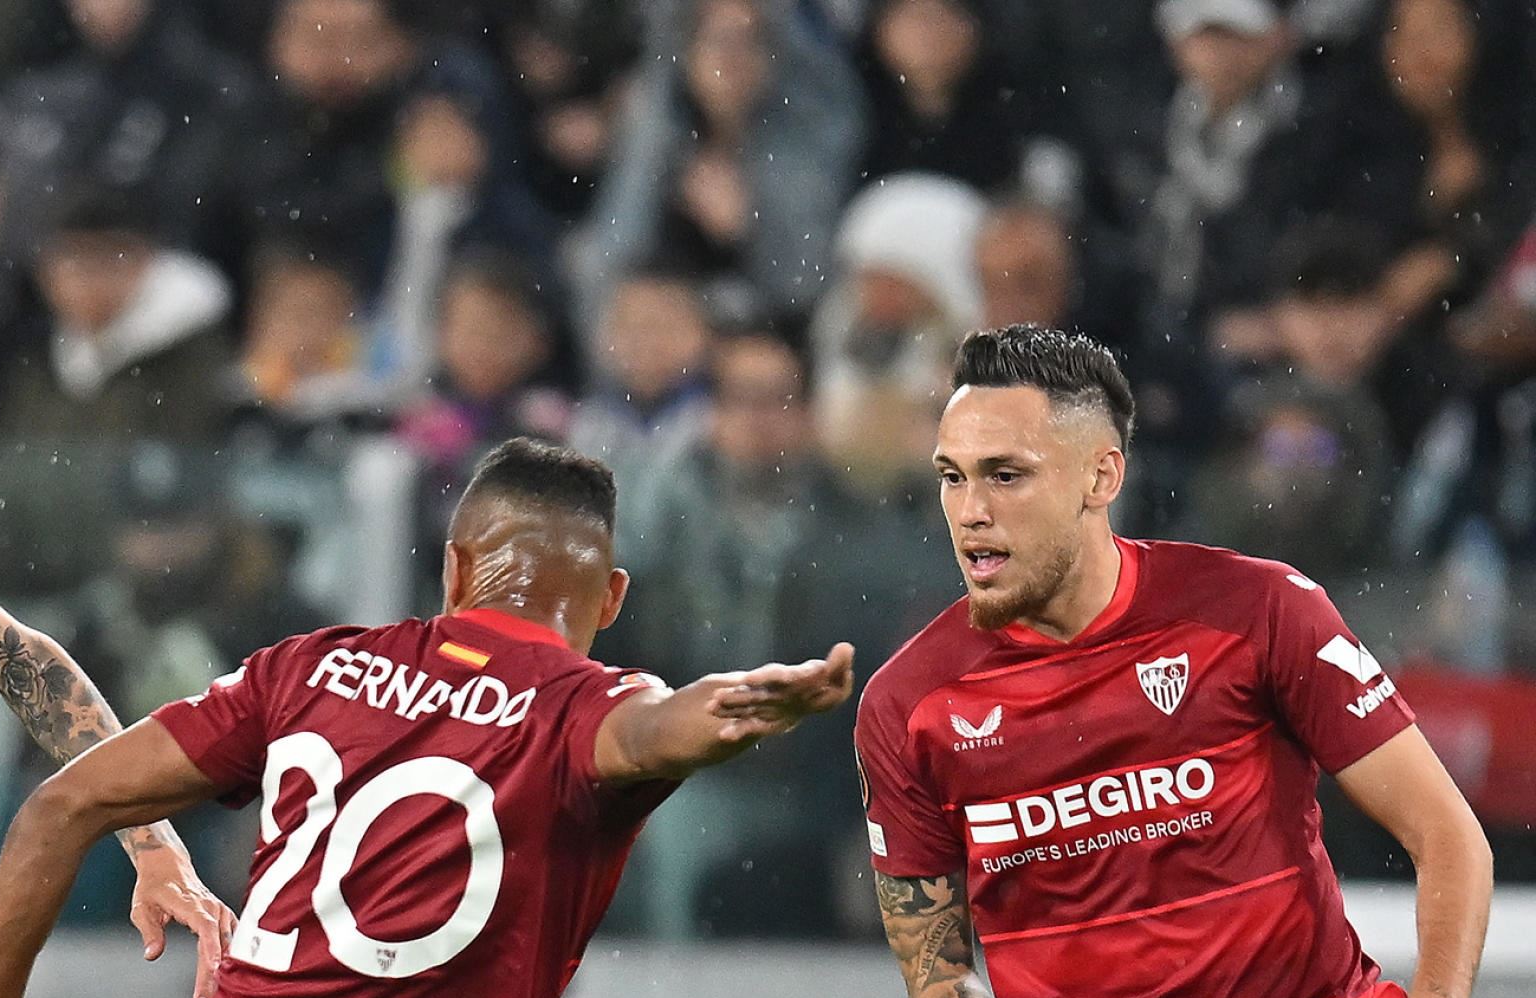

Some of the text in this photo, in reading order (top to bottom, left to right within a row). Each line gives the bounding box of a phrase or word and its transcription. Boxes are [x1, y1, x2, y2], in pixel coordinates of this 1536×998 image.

[1015, 758, 1215, 838] DEGIRO
[228, 731, 505, 979] 20
[981, 810, 1214, 874] EUROPE'S LEADING BROKER
